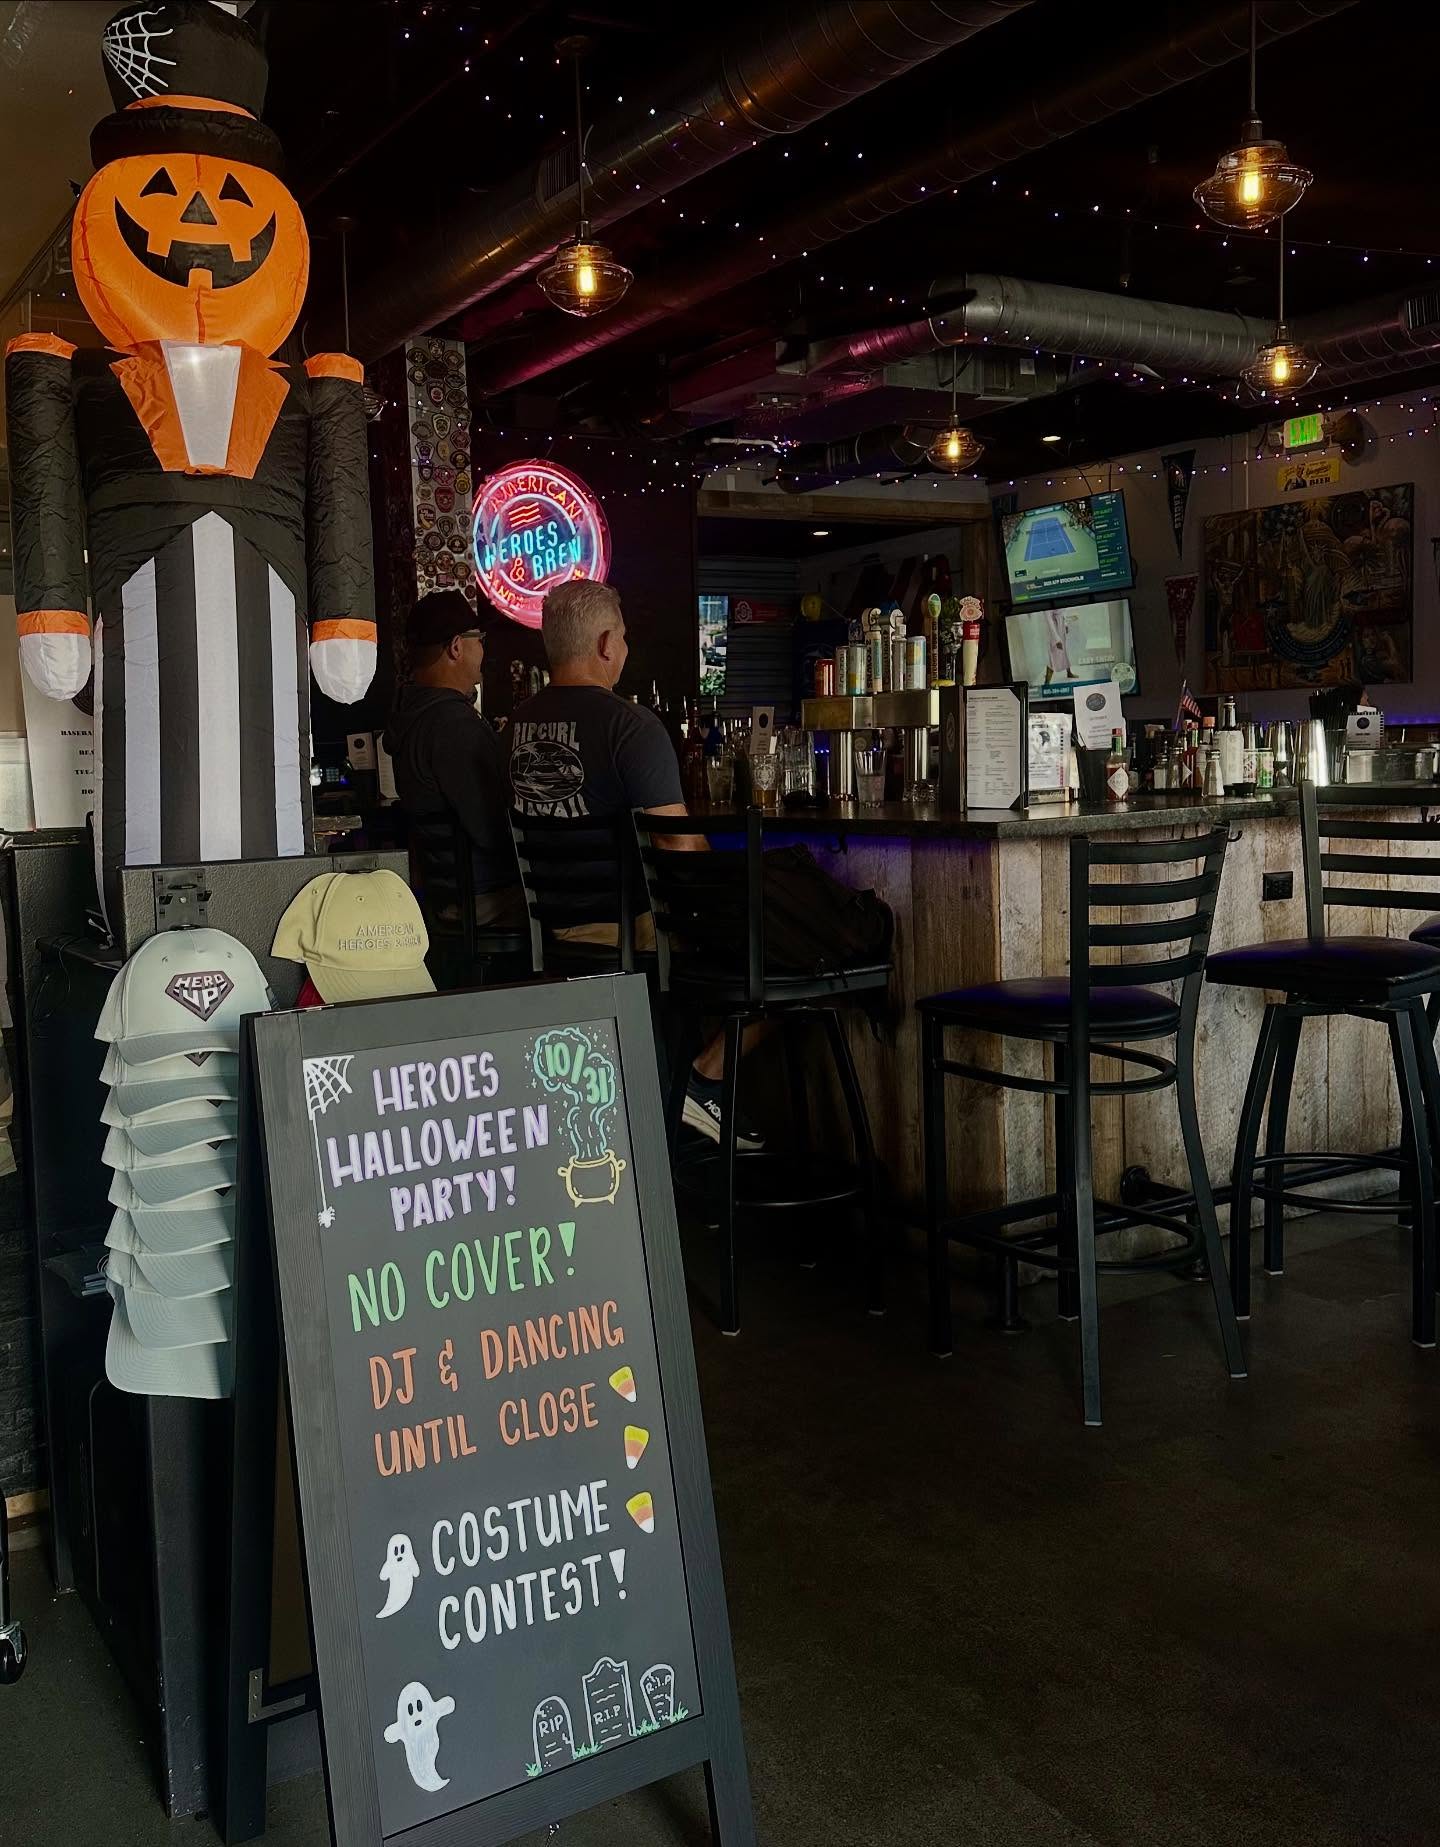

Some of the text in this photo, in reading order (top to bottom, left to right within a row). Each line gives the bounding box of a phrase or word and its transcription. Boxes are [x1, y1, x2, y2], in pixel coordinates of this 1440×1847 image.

[490, 475, 583, 519] AMERICAN
[483, 520, 559, 571] HEROES
[509, 534, 583, 583] & BREW
[338, 937, 391, 951] HEROES
[174, 974, 225, 988] HERO
[175, 985, 224, 1010] UP
[372, 1051, 500, 1116] HEROES
[326, 1103, 550, 1189] HALLOWEEN
[389, 1165, 517, 1233] PARTY!
[347, 1221, 577, 1333] NO COVER!
[368, 1299, 626, 1411] DJ & DANCING
[373, 1381, 600, 1478] UNTIL CLOSE
[430, 1479, 611, 1577] COSTUME
[437, 1547, 628, 1651] CONTEST!
[644, 1674, 673, 1695] R.I.P
[537, 1713, 565, 1738] RIP
[592, 1704, 622, 1726] R.I.P
